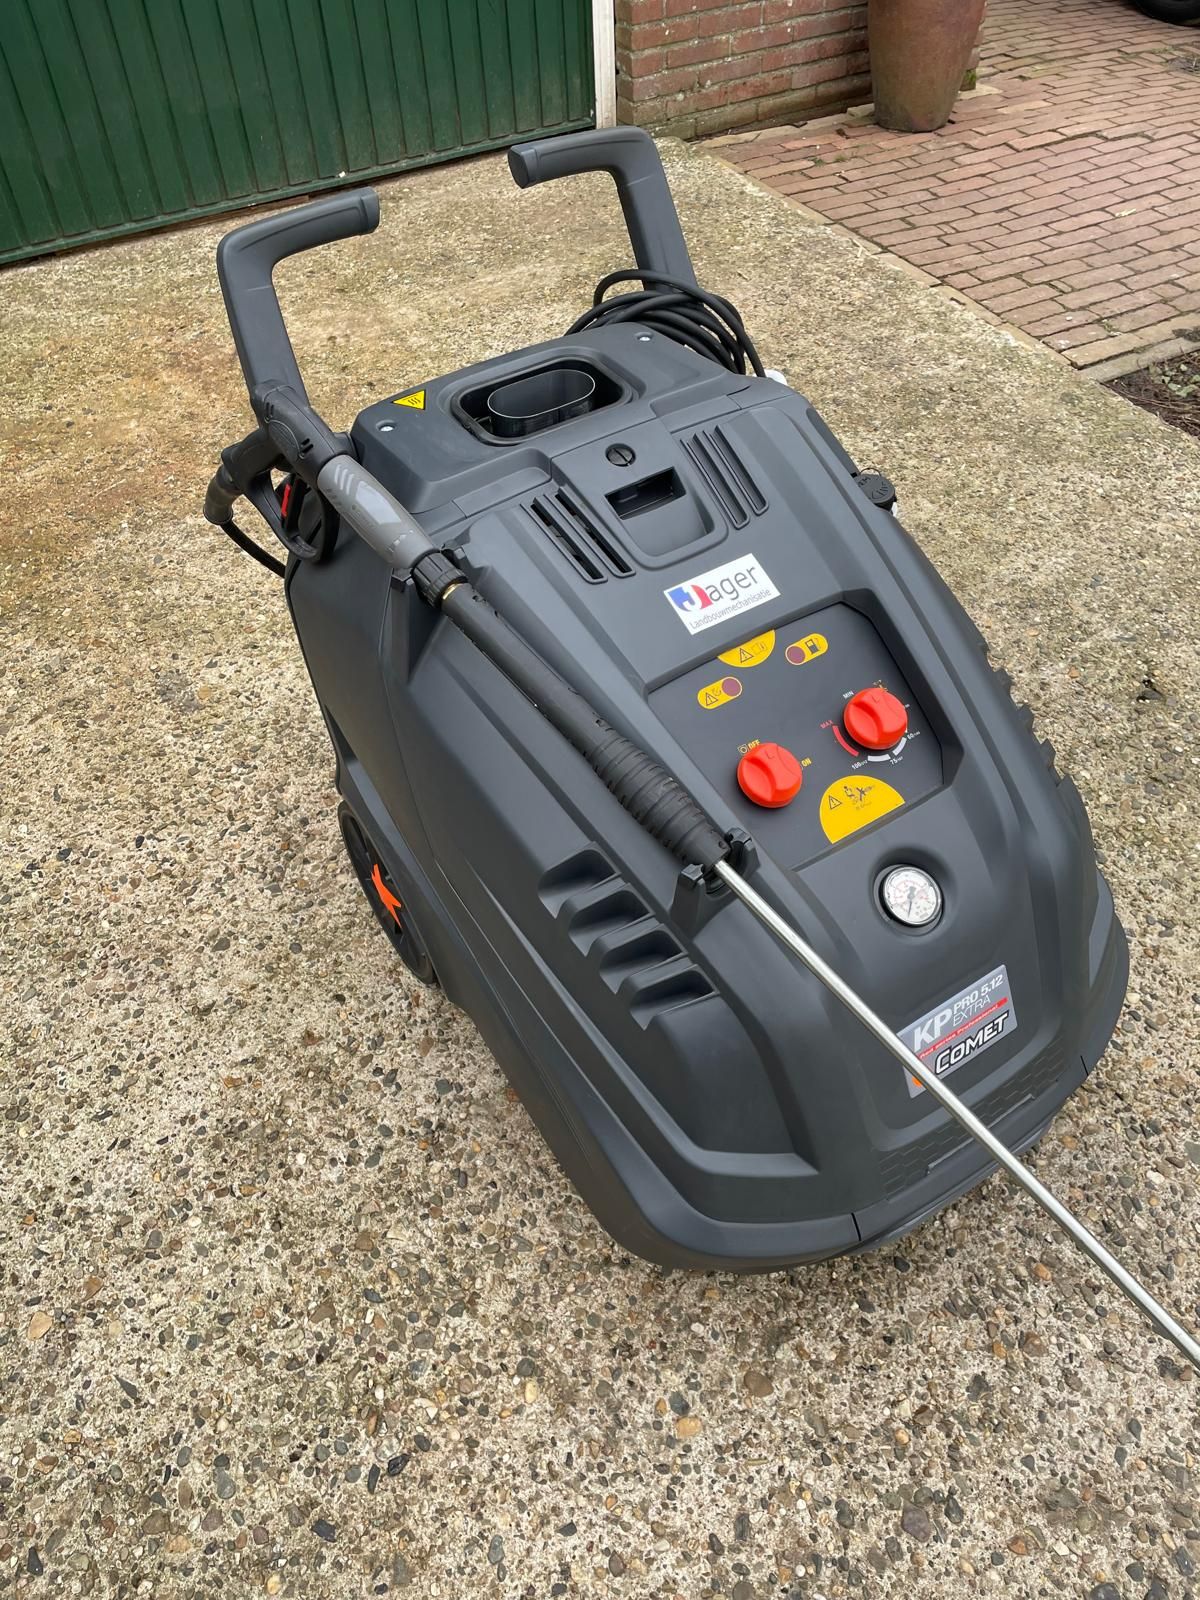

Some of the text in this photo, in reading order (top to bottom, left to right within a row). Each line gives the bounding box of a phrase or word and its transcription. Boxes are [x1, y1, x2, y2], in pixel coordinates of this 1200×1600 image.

[689, 589, 772, 630] Landbouwmechanisatie
[843, 690, 855, 699] MIN
[821, 720, 834, 729] MAX
[802, 758, 812, 767] ON
[914, 974, 1004, 1053] KP PRO 5.12
[953, 995, 991, 1027] EXTRA
[935, 1010, 1010, 1075] COMET
